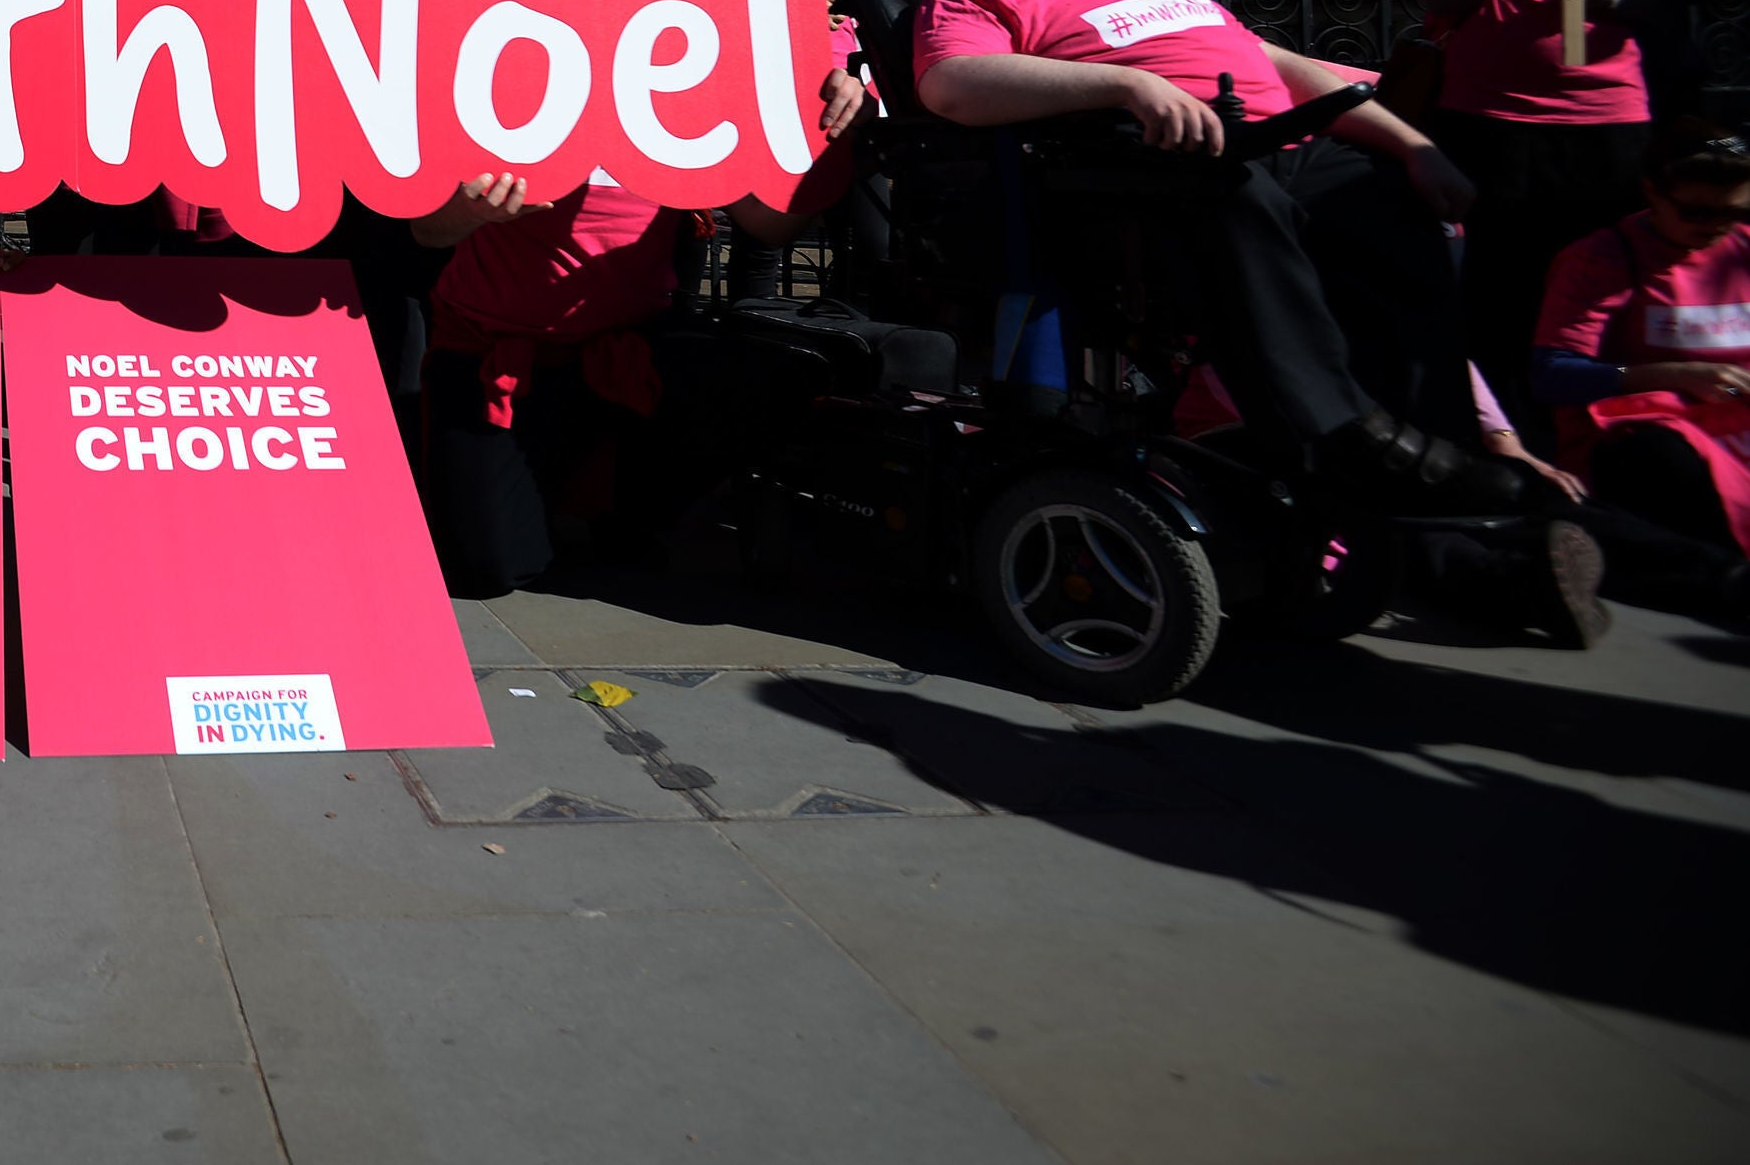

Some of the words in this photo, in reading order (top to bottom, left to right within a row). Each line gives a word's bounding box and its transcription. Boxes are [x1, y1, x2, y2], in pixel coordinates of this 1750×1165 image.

[66, 355, 161, 377] NOEL
[172, 355, 317, 377] CONWAY
[70, 386, 330, 417] DESERVES
[76, 427, 346, 471] CHOICE
[191, 690, 274, 702] CAMPAIGN
[278, 689, 308, 700] FOR
[194, 703, 310, 722] DIGNITY
[197, 726, 225, 744] IN
[231, 724, 326, 743] DYING.
